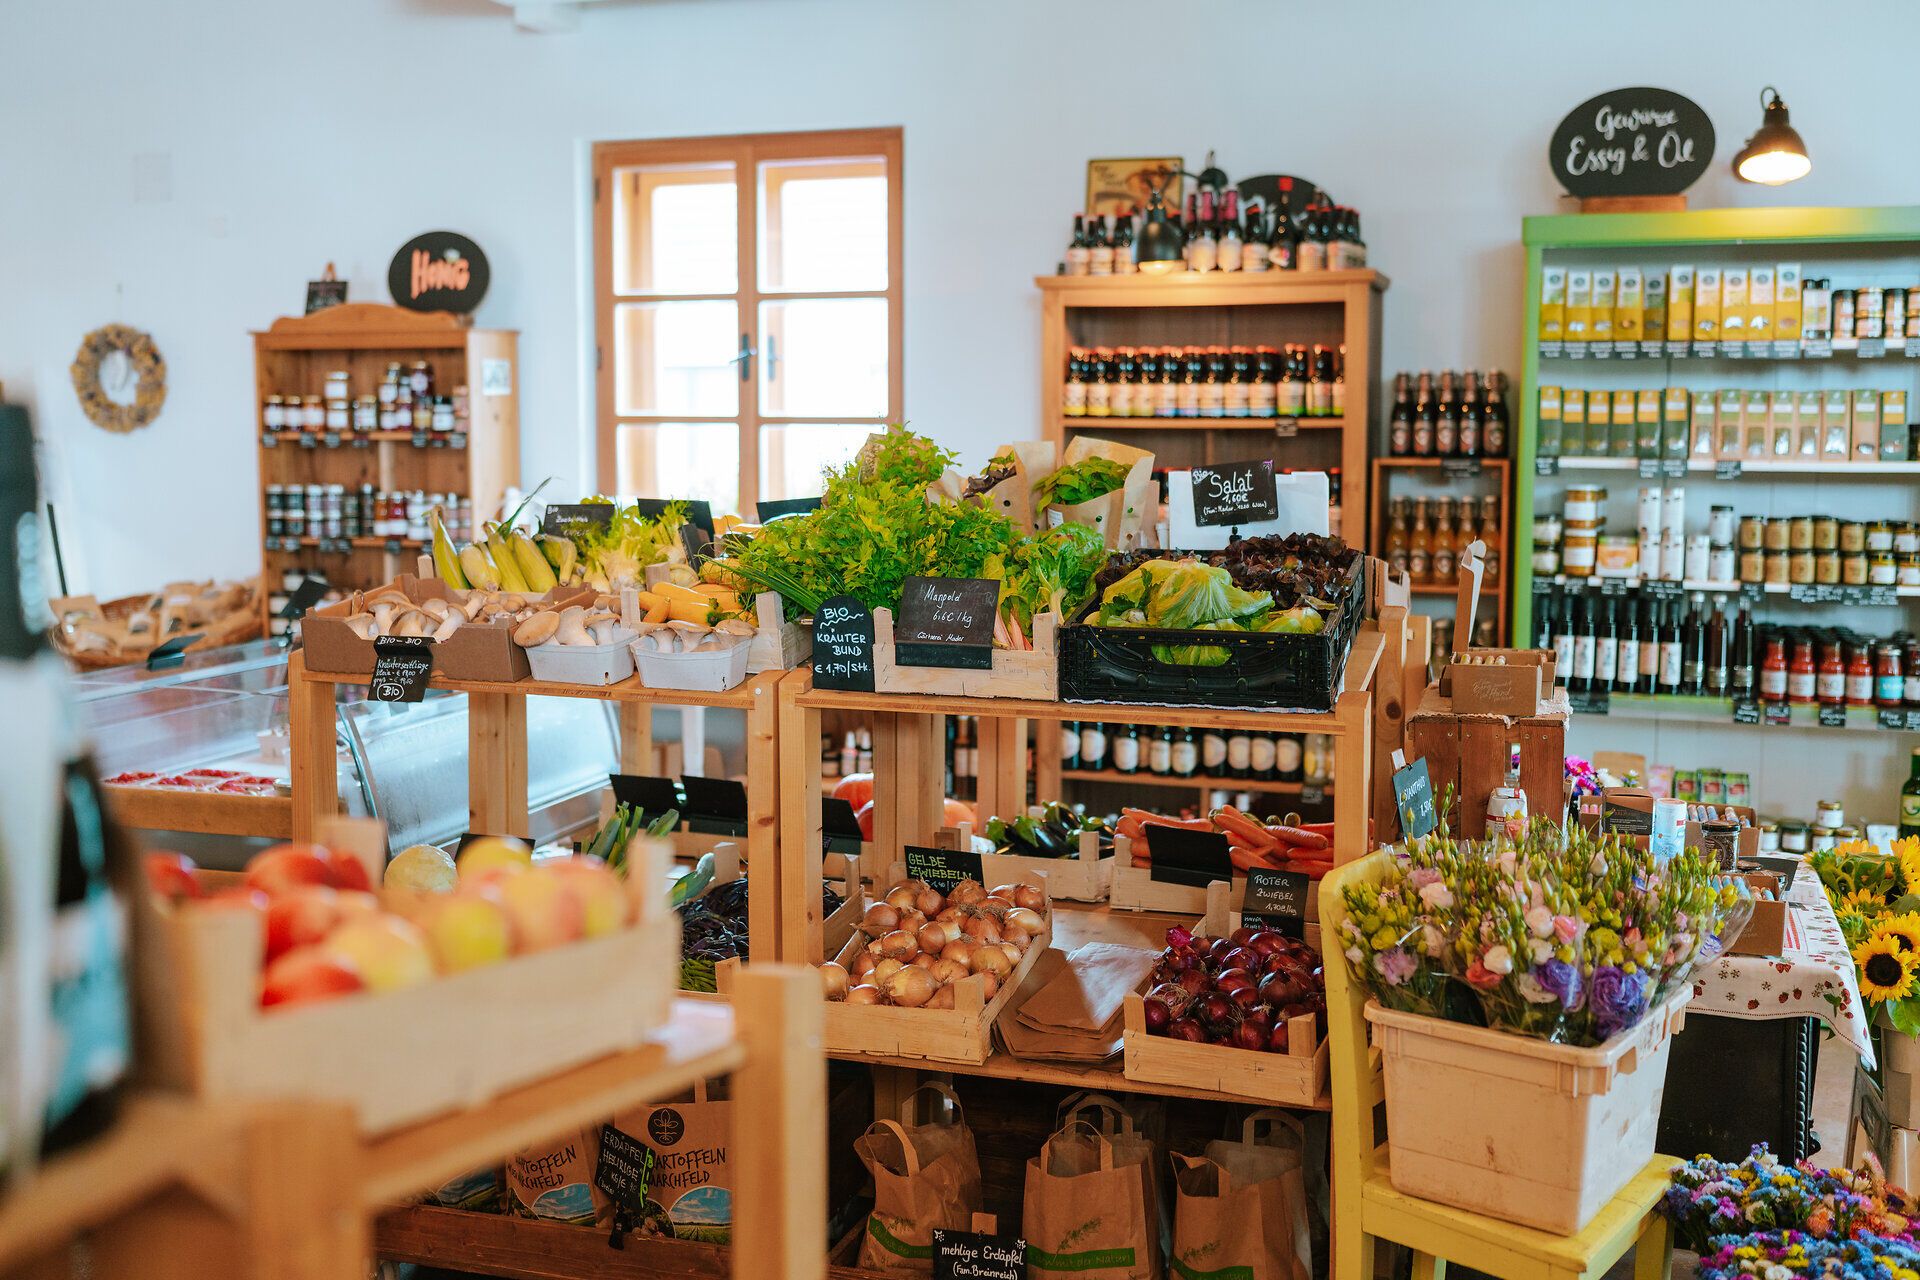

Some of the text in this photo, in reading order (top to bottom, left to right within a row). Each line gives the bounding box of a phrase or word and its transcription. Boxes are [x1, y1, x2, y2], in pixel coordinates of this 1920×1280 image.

[1566, 135, 1626, 176] Essig
[1631, 133, 1650, 162] &
[1208, 469, 1255, 498] Salat
[924, 584, 962, 608] Mangold
[823, 607, 849, 619] BIO
[377, 636, 396, 645] BIO
[405, 637, 422, 646] BIO
[816, 628, 867, 644] KRÄUTER
[832, 645, 862, 656] BUND
[814, 664, 823, 674] €
[383, 685, 400, 696] BIO
[908, 853, 947, 868] GELBE
[909, 866, 972, 880] ZWIEBELN
[1254, 874, 1290, 887] ROTER
[1256, 887, 1294, 901] ZWIEBEL
[941, 1243, 978, 1263] mehlige
[983, 1246, 1024, 1267] Erdäpfel
